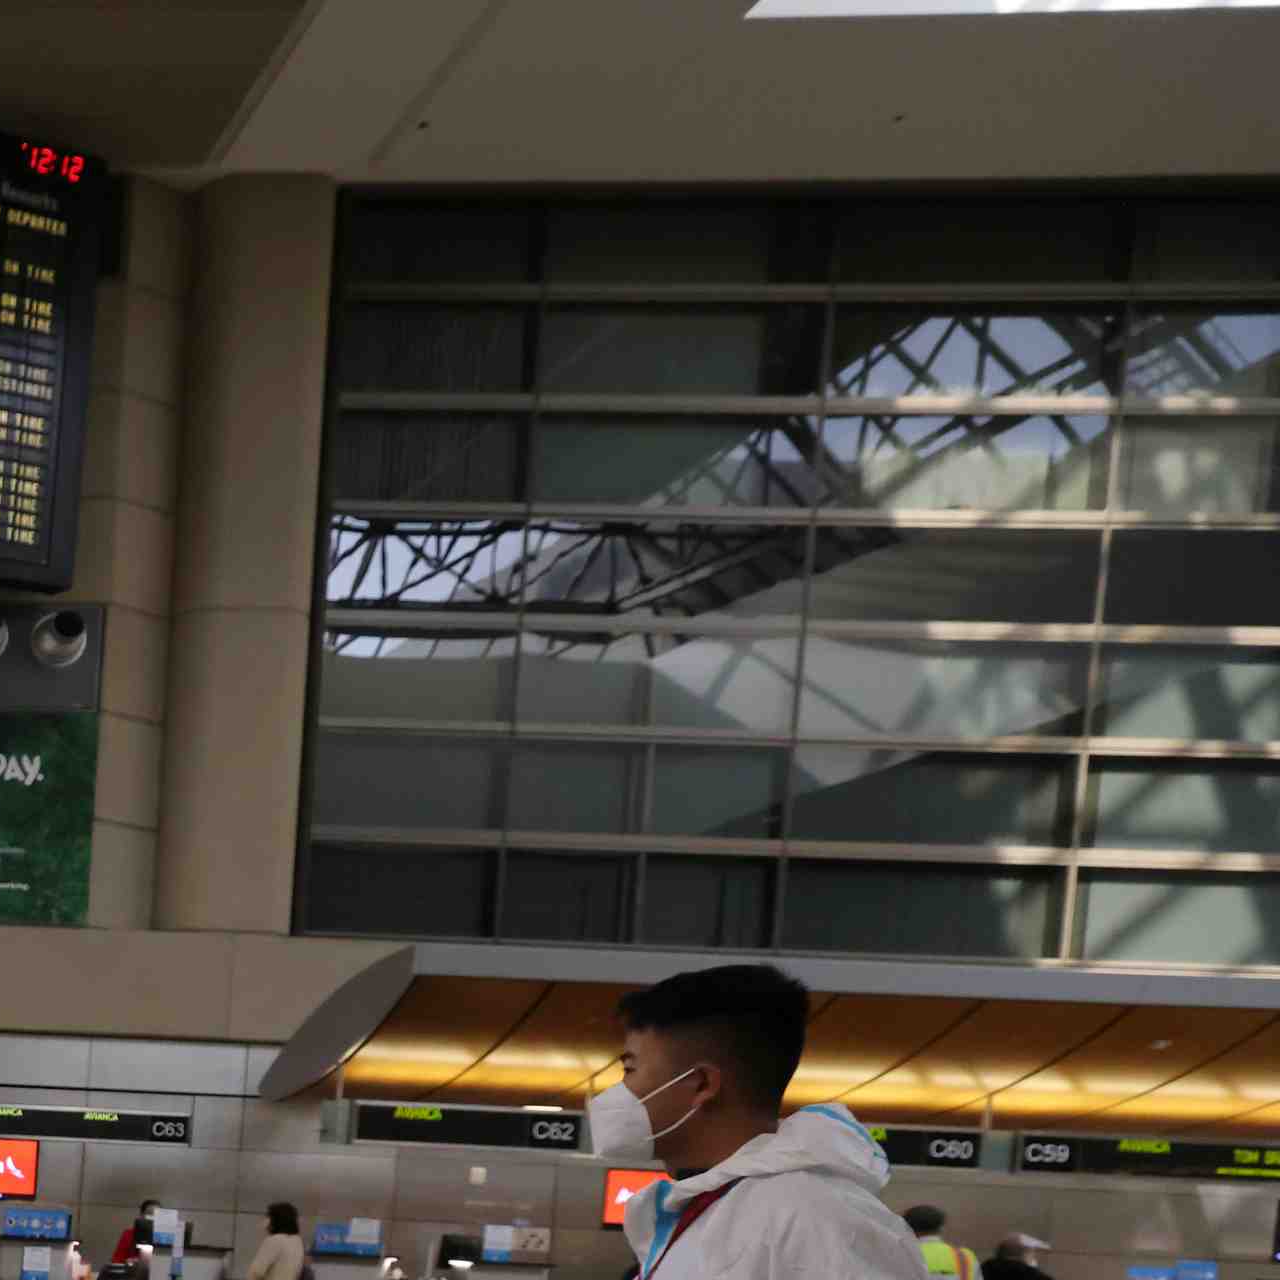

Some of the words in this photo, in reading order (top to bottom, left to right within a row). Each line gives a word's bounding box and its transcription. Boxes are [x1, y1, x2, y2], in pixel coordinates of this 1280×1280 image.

[84, 1111, 119, 1122] AVIANCA
[152, 1121, 185, 1138] C63
[532, 1121, 575, 1141] C62
[1025, 1143, 1070, 1164] C59
